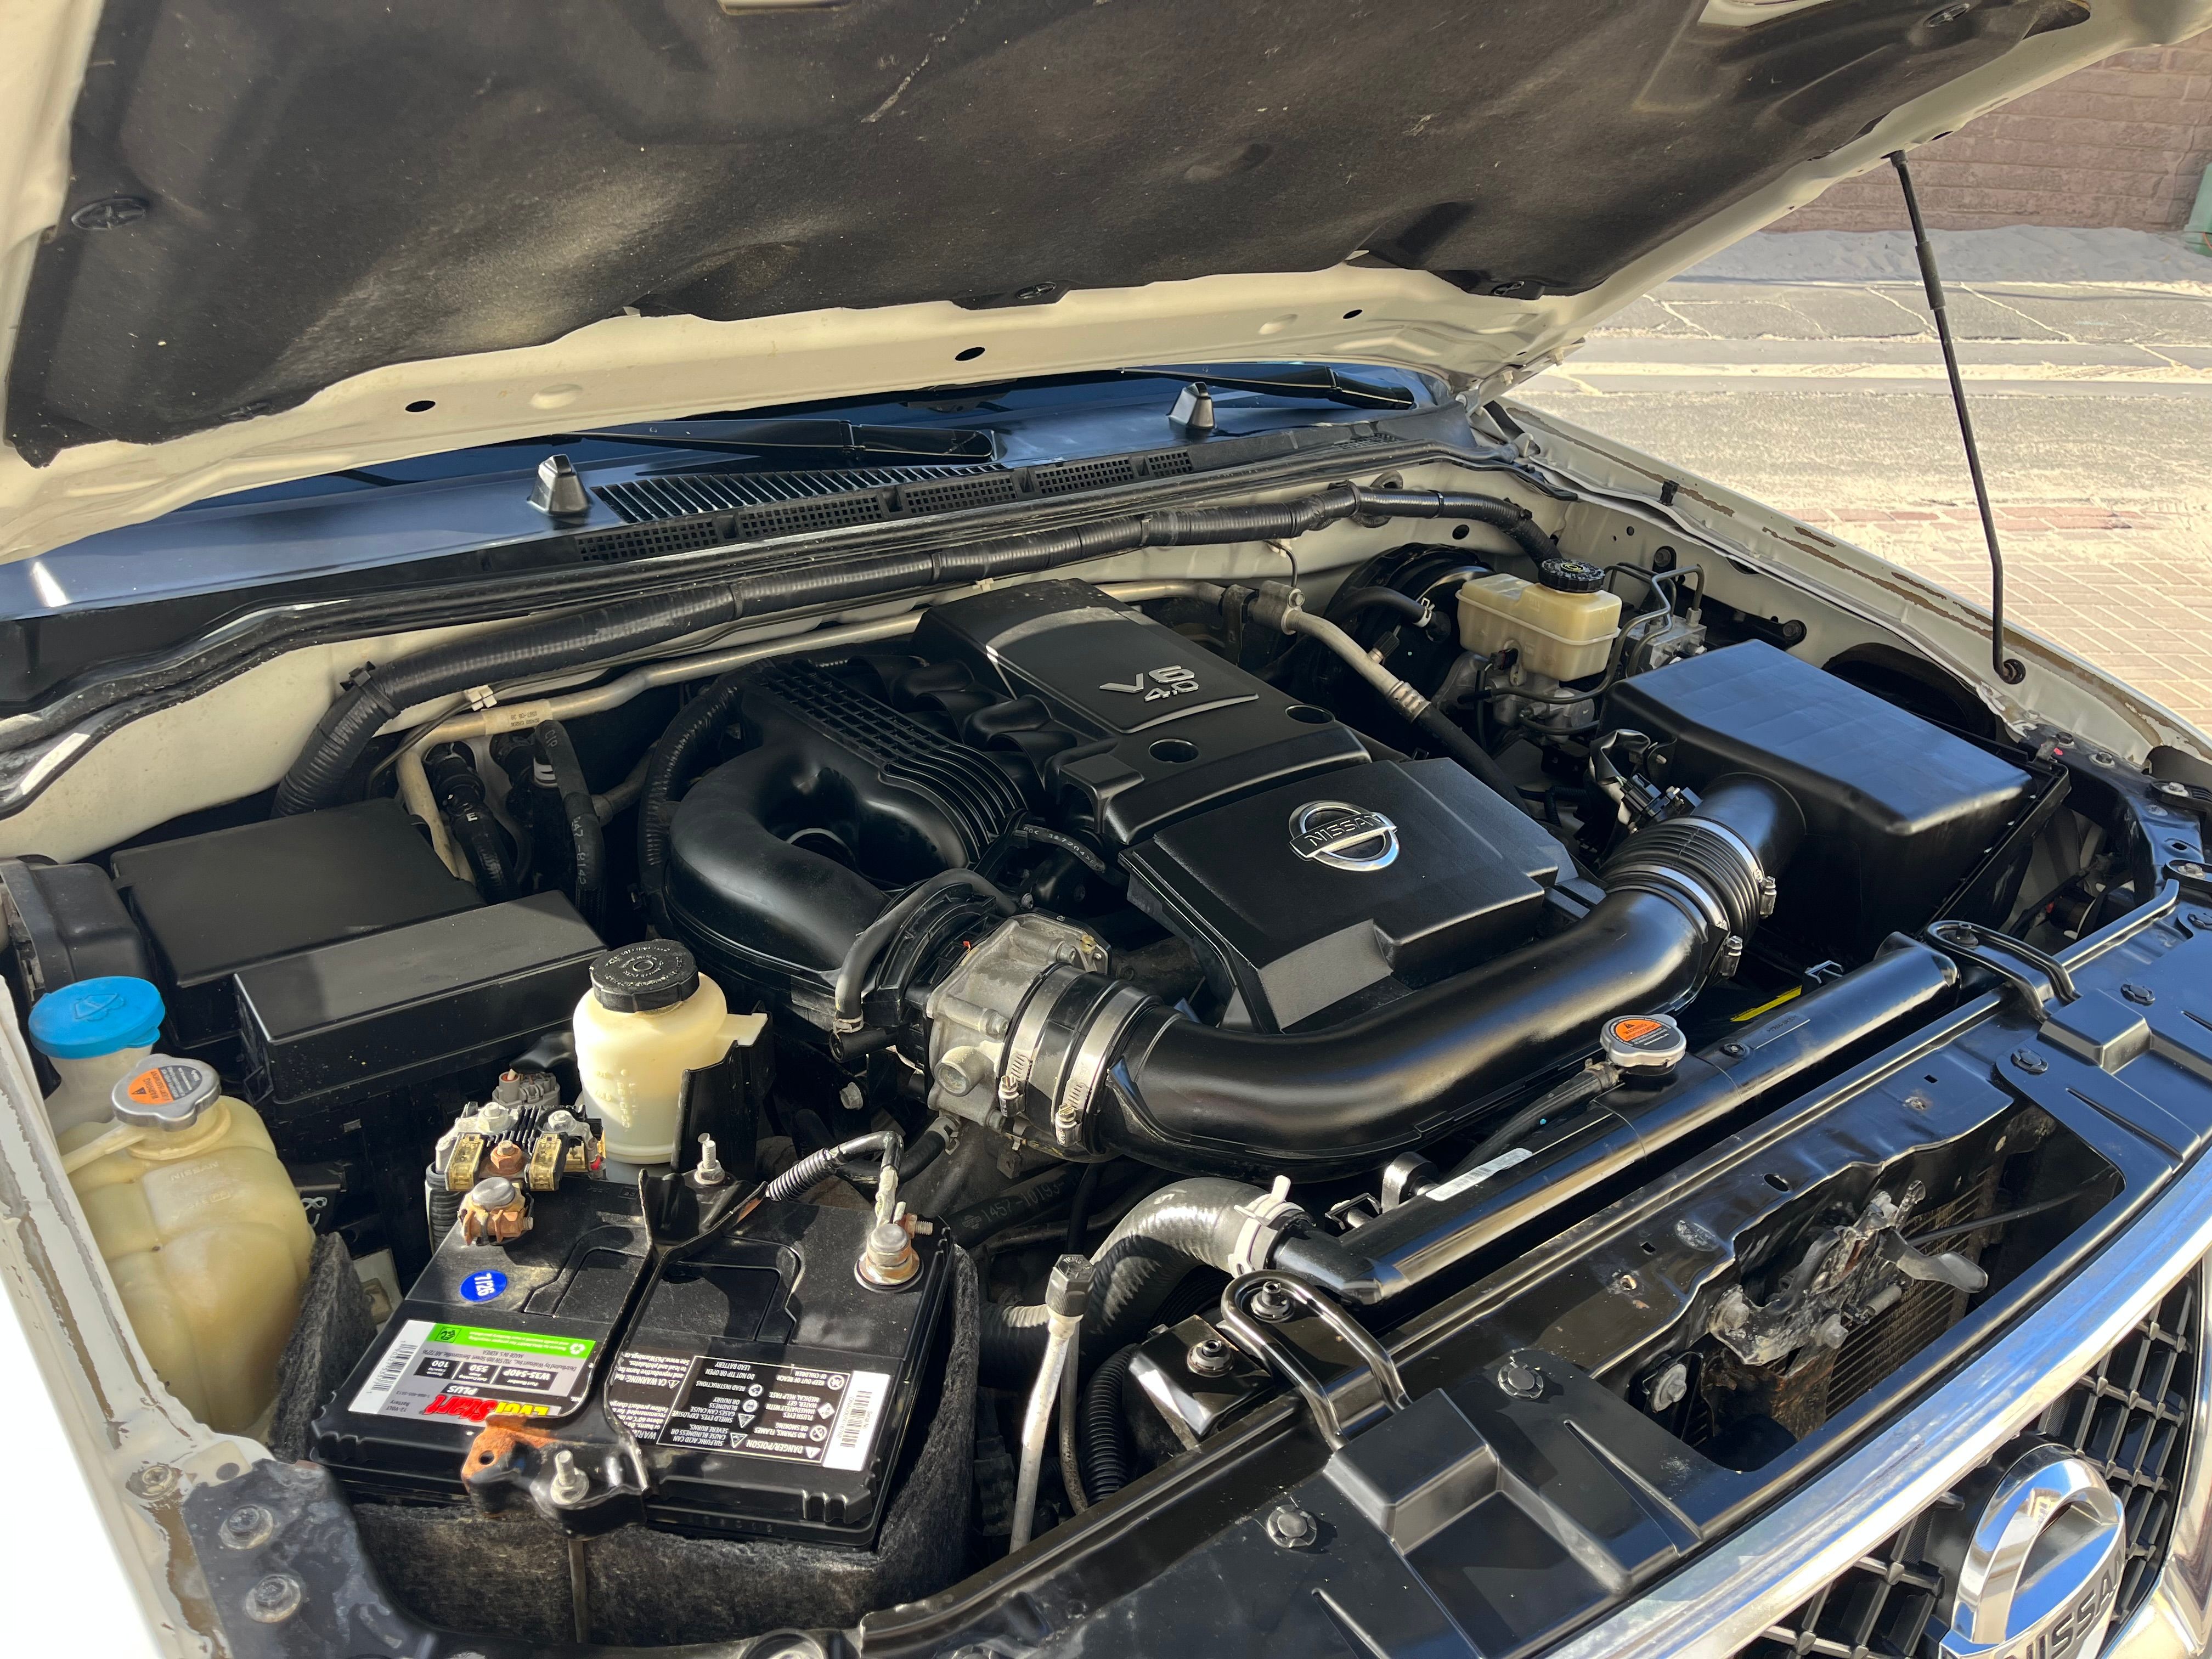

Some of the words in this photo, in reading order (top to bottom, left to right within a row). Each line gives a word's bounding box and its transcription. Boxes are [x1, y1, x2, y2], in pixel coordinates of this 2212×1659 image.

[1099, 665, 1195, 693] V6
[1144, 680, 1199, 702] 4.0
[1304, 812, 1389, 847] NISSAN
[171, 1161, 219, 1181] NISSAN
[474, 1273, 495, 1296] 7/26
[503, 1369, 550, 1380] W35-540P
[625, 1375, 657, 1385] WARNING:
[696, 1380, 732, 1390] INSTRUCTIONS
[447, 1385, 478, 1395] PLUS
[709, 1402, 738, 1410] BLINDNESS
[781, 1406, 815, 1414] IMMEDIATELY
[672, 1410, 699, 1419] EXPLOSIVE
[864, 1411, 872, 1423] Serial
[680, 1429, 708, 1438] BLINDNESS
[776, 1429, 797, 1437] SPARKS,
[746, 1438, 803, 1453] DANGER/POISON
